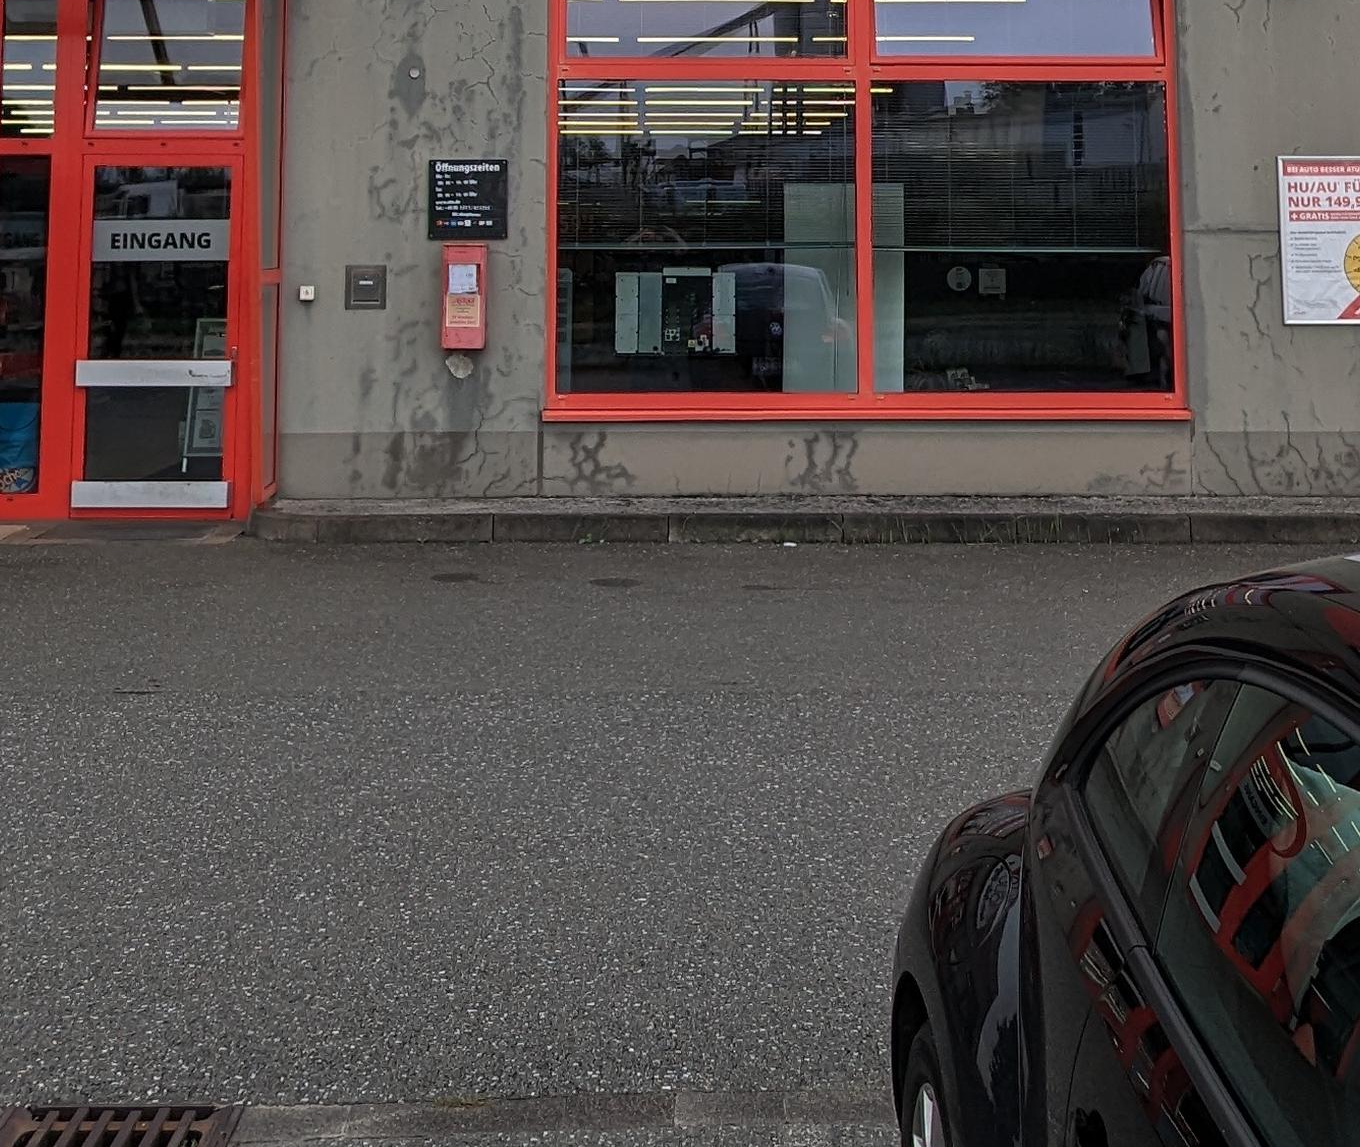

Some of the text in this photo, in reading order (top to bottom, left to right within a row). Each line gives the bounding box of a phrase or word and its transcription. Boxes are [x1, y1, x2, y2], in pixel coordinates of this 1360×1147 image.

[435, 161, 500, 174] Öffnungszeiten
[1288, 196, 1321, 208] NUR
[1300, 213, 1330, 221] GRATIS
[110, 232, 211, 250] EINGANG
